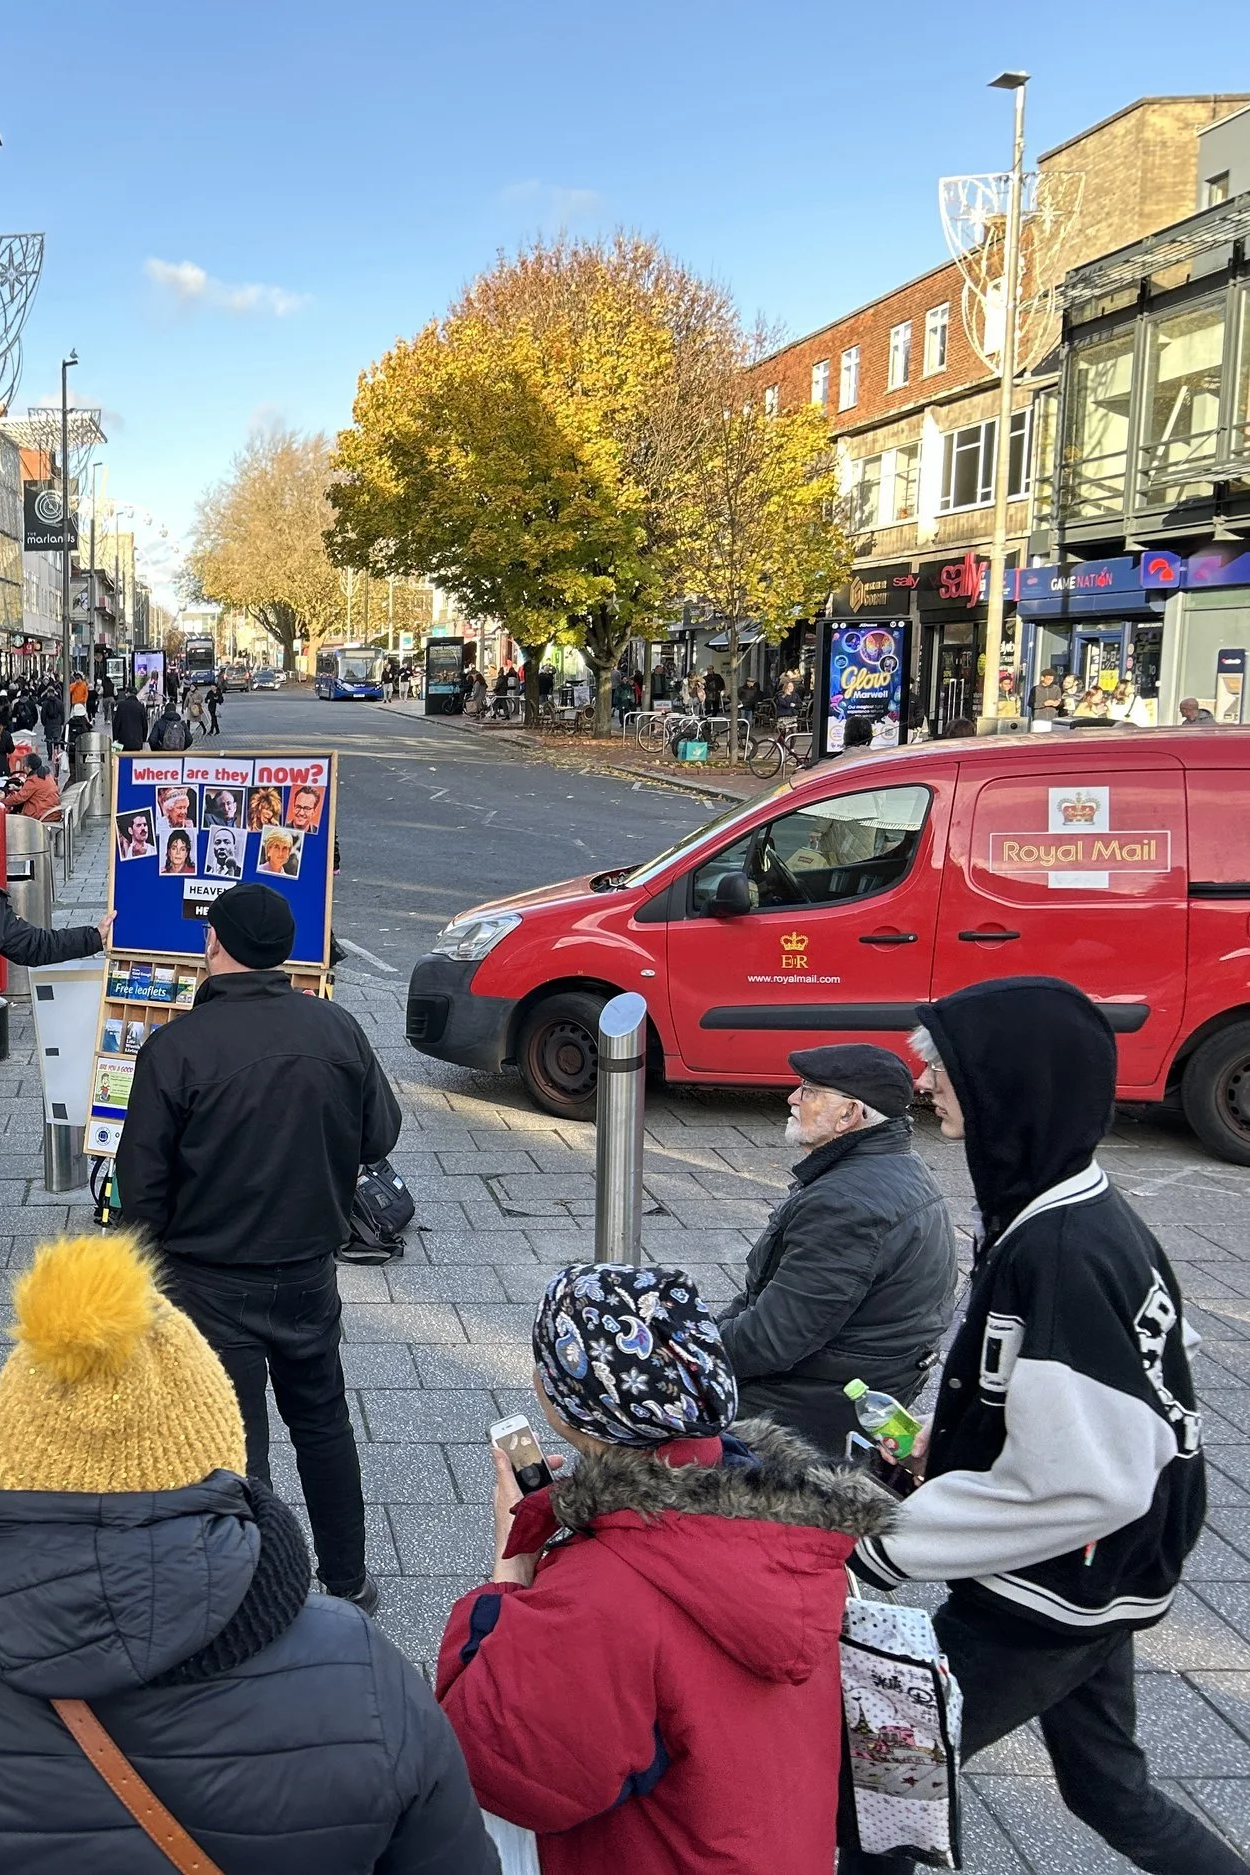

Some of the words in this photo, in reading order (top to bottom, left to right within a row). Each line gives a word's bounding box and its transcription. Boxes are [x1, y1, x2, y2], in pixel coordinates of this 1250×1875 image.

[892, 574, 920, 589] sally
[940, 551, 989, 609] sally
[841, 666, 891, 699] Glow
[853, 690, 888, 699] Marwell
[186, 768, 209, 780] are
[215, 767, 249, 784] they
[1003, 840, 1083, 867] Royal
[1091, 839, 1156, 861] Mail
[189, 885, 227, 896] HEAVE
[747, 974, 841, 985] www.royalmail.com
[115, 982, 134, 994] Free
[134, 984, 167, 998] leaflets
